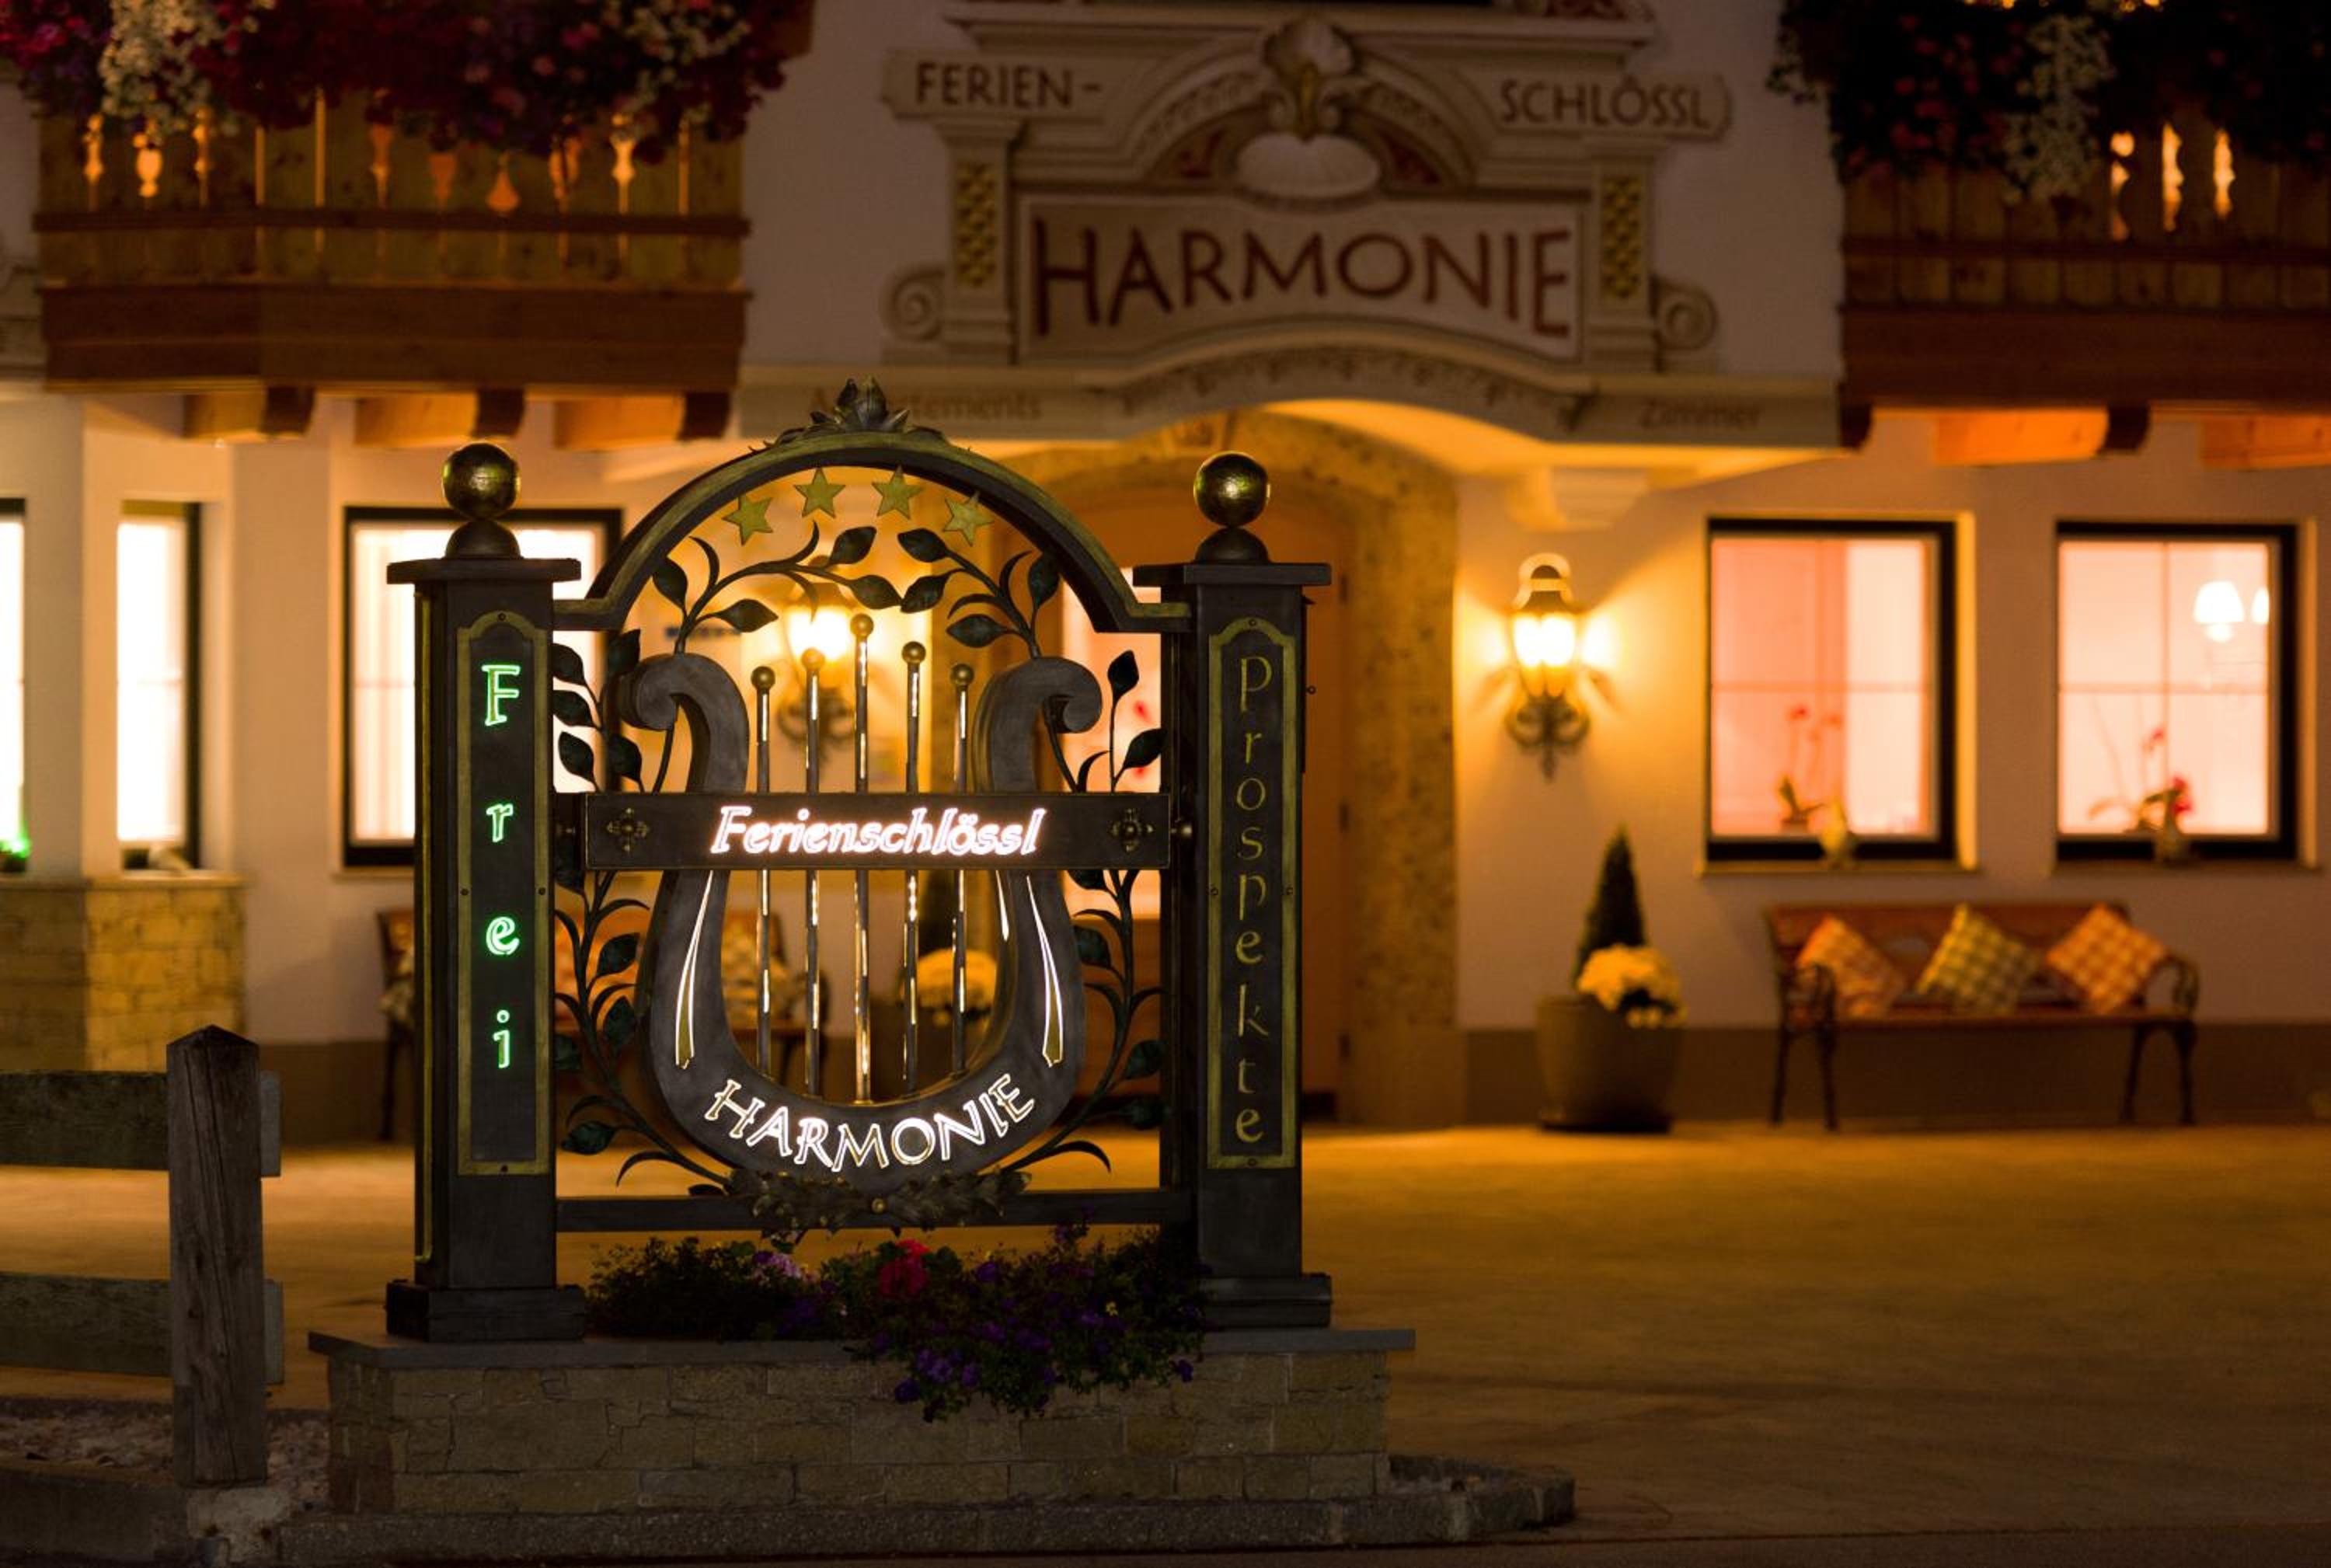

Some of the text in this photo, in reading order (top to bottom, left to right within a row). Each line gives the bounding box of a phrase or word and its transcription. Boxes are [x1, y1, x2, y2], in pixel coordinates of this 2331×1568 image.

[1034, 217, 1570, 338] HARMONIE
[481, 664, 521, 1069] Frei
[710, 805, 1046, 855] Ferienschlössl
[704, 1072, 1035, 1173] HARMONIE
